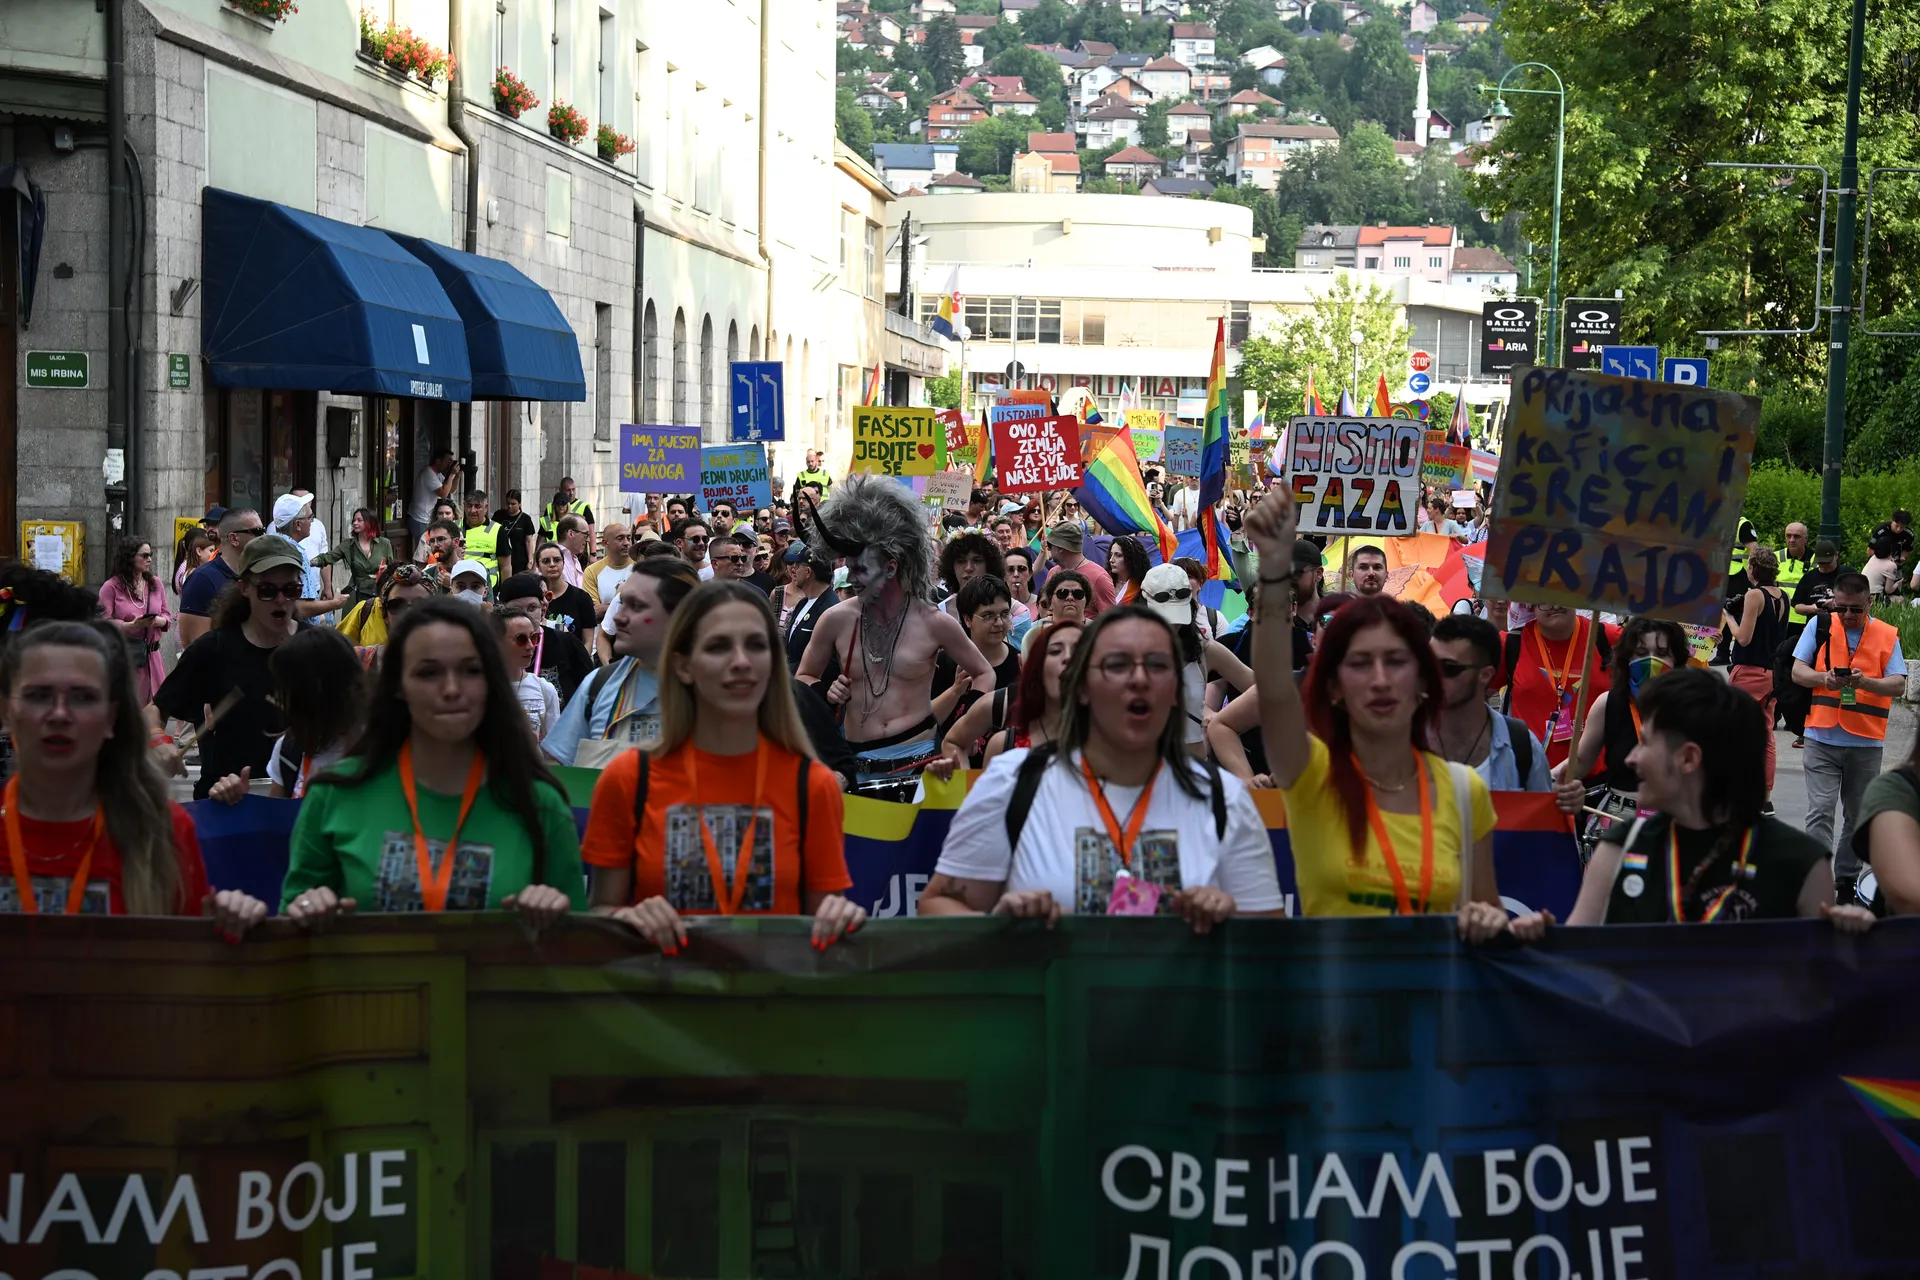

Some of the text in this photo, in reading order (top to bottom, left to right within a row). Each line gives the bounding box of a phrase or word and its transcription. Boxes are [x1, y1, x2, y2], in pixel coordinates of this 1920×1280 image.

[1505, 342, 1528, 351] ARIA
[1589, 344, 1603, 353] AR
[1410, 357, 1430, 367] STOP
[30, 368, 84, 378] MIS IRBINA
[1674, 364, 1698, 385] P
[858, 414, 932, 438] FAŠISTI
[1009, 421, 1059, 438] OVO JE
[631, 434, 699, 449] IMA MJESTA
[1291, 422, 1421, 477] NISMO
[648, 448, 666, 461] ZA
[744, 451, 759, 465] SE
[855, 441, 917, 461] JEDITE
[882, 461, 903, 476] SE
[1014, 453, 1066, 468] ZA SVE
[1170, 459, 1200, 473] UNITE
[623, 463, 685, 480] SVAKOGA
[700, 467, 767, 486] JEDNI DRUGIH
[1005, 468, 1041, 486] NAŠE
[703, 484, 749, 498] BOJIMO SE
[1291, 475, 1408, 531] FAZA
[1508, 466, 1722, 539] SRETAN
[1502, 524, 1710, 613] PRAJD
[1101, 1136, 1657, 1226] СВЕ НАМ БОЈЕ
[235, 1149, 407, 1241] BOJE
